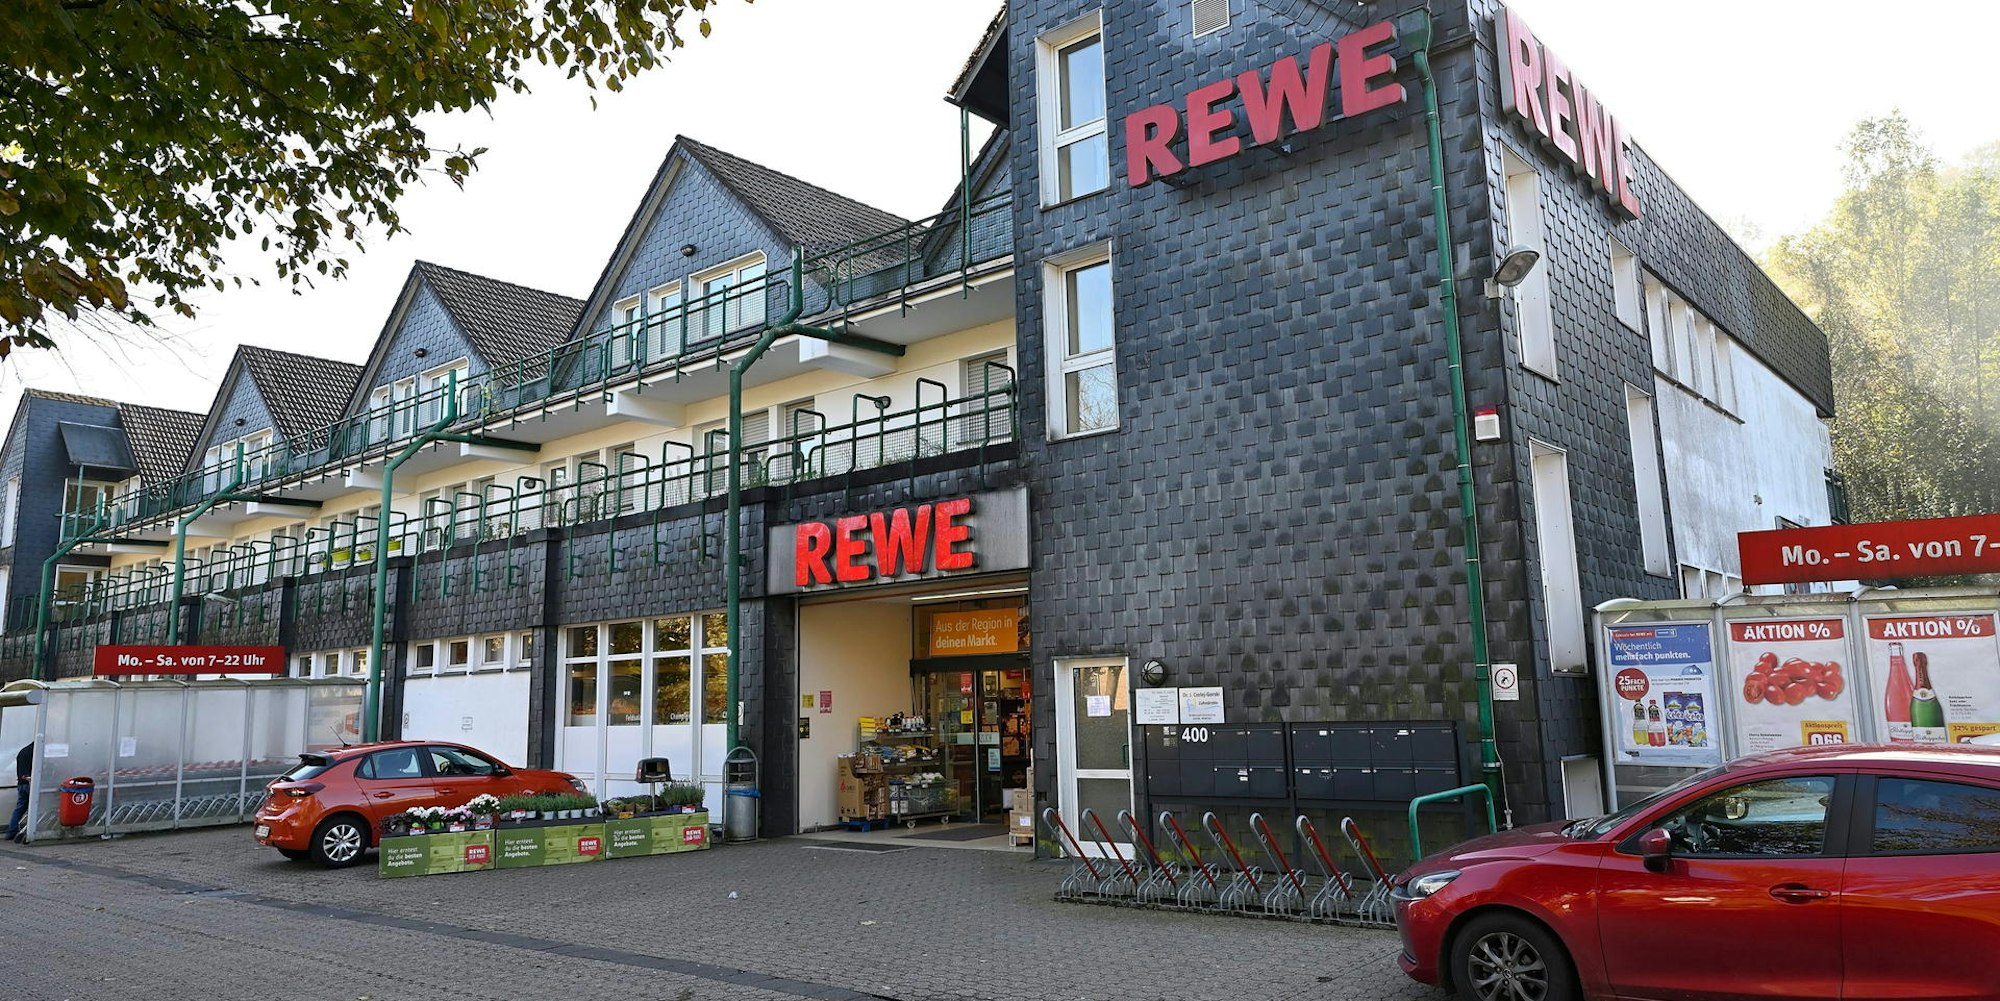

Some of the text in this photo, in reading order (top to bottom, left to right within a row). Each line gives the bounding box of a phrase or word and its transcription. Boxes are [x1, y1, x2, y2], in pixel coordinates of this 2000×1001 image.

[1126, 20, 1406, 188] REWE
[1494, 6, 1642, 220] REWE
[795, 498, 974, 587] REWE
[1781, 544, 1829, 567] Mo.
[1857, 540, 1900, 563] Sa.
[1908, 538, 1962, 560] von
[935, 615, 1012, 633] Aus der Region in
[1744, 622, 1831, 640] AKTION %
[1883, 619, 1981, 637] AKTION %
[935, 633, 998, 649] deinen Markt.
[1614, 642, 1662, 652] Wöchentlich
[117, 654, 143, 667] Mo.
[156, 654, 177, 667] Sa.
[181, 657, 204, 667] von
[208, 655, 240, 667] 7–22
[243, 653, 265, 667] Uhr
[1615, 650, 1691, 661] mehrfach punkten.
[1620, 684, 1645, 692] PUNKTE
[1804, 722, 1843, 730] Aktionspreis
[1970, 725, 1997, 733] gespart
[1181, 727, 1208, 743] 400
[613, 840, 639, 848] Angebote.
[404, 852, 423, 860] besten
[504, 850, 531, 858] Angebote.
[387, 859, 415, 868] Angebote.
